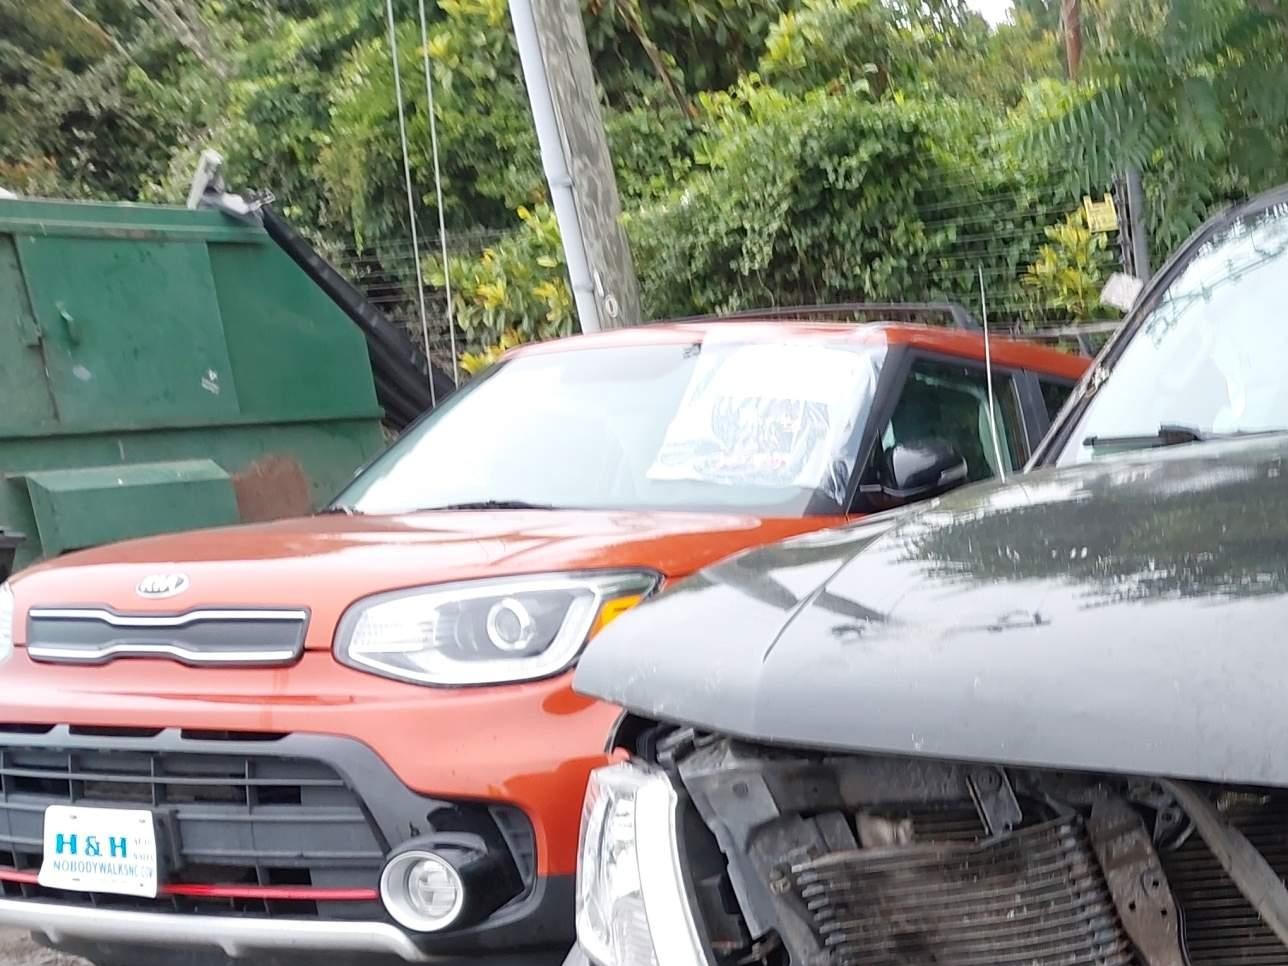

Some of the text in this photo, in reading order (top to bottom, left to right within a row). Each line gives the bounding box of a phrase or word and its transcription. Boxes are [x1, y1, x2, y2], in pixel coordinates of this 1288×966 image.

[56, 833, 77, 854] H
[85, 835, 103, 856] &
[109, 836, 127, 858] H
